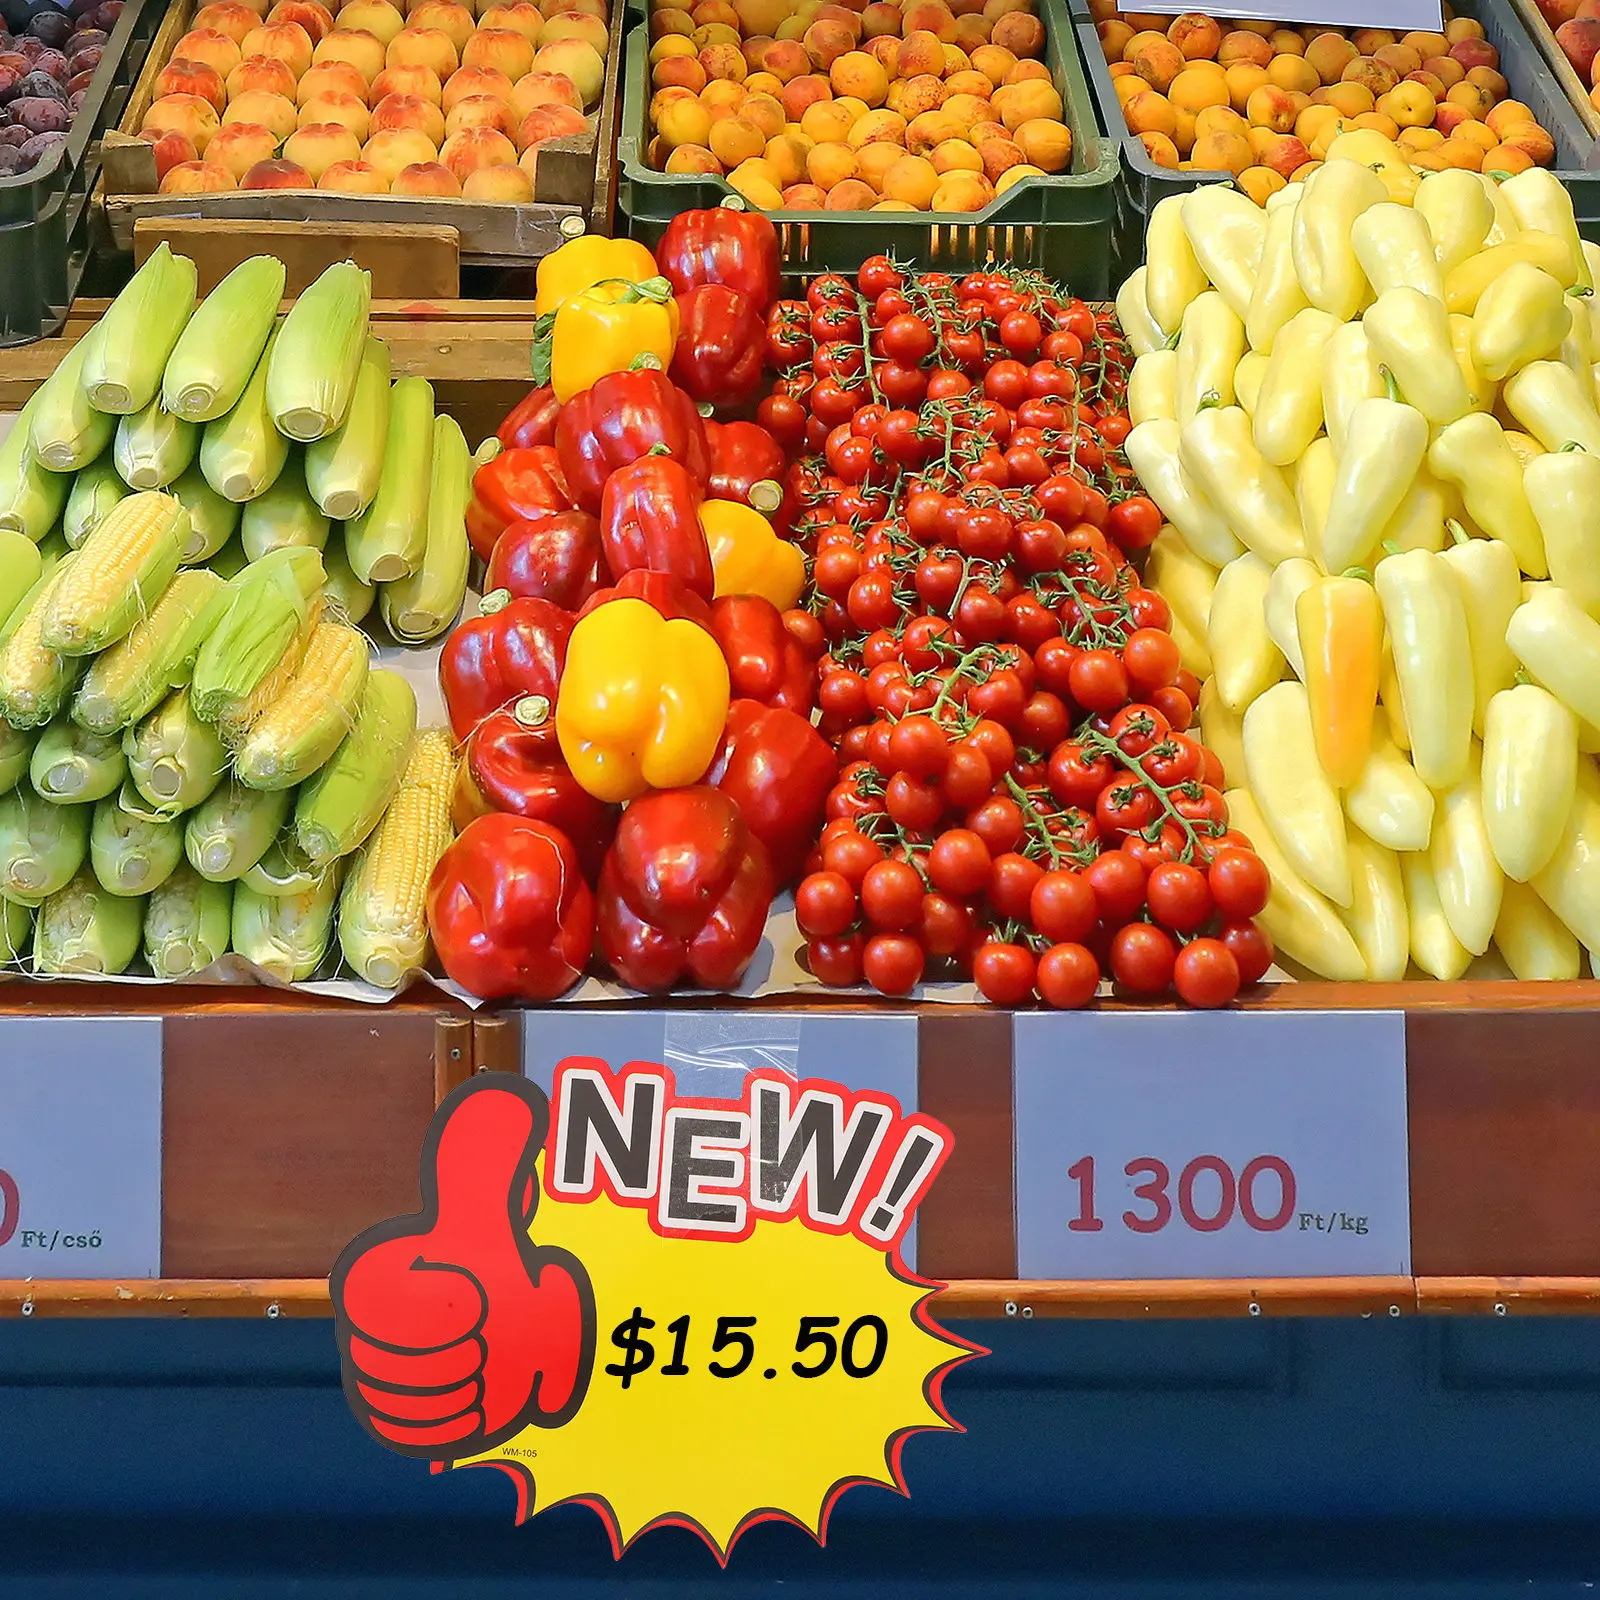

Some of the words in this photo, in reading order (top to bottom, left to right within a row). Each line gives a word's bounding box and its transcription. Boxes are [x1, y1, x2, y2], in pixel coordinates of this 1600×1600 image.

[553, 1068, 944, 1241] NEW!
[1067, 1154, 1297, 1233] 1300
[1299, 1213, 1369, 1235] Ft/kg
[21, 1230, 102, 1251] Ft/cső
[605, 1306, 889, 1389] $15.50
[502, 1447, 538, 1458] WM-105
